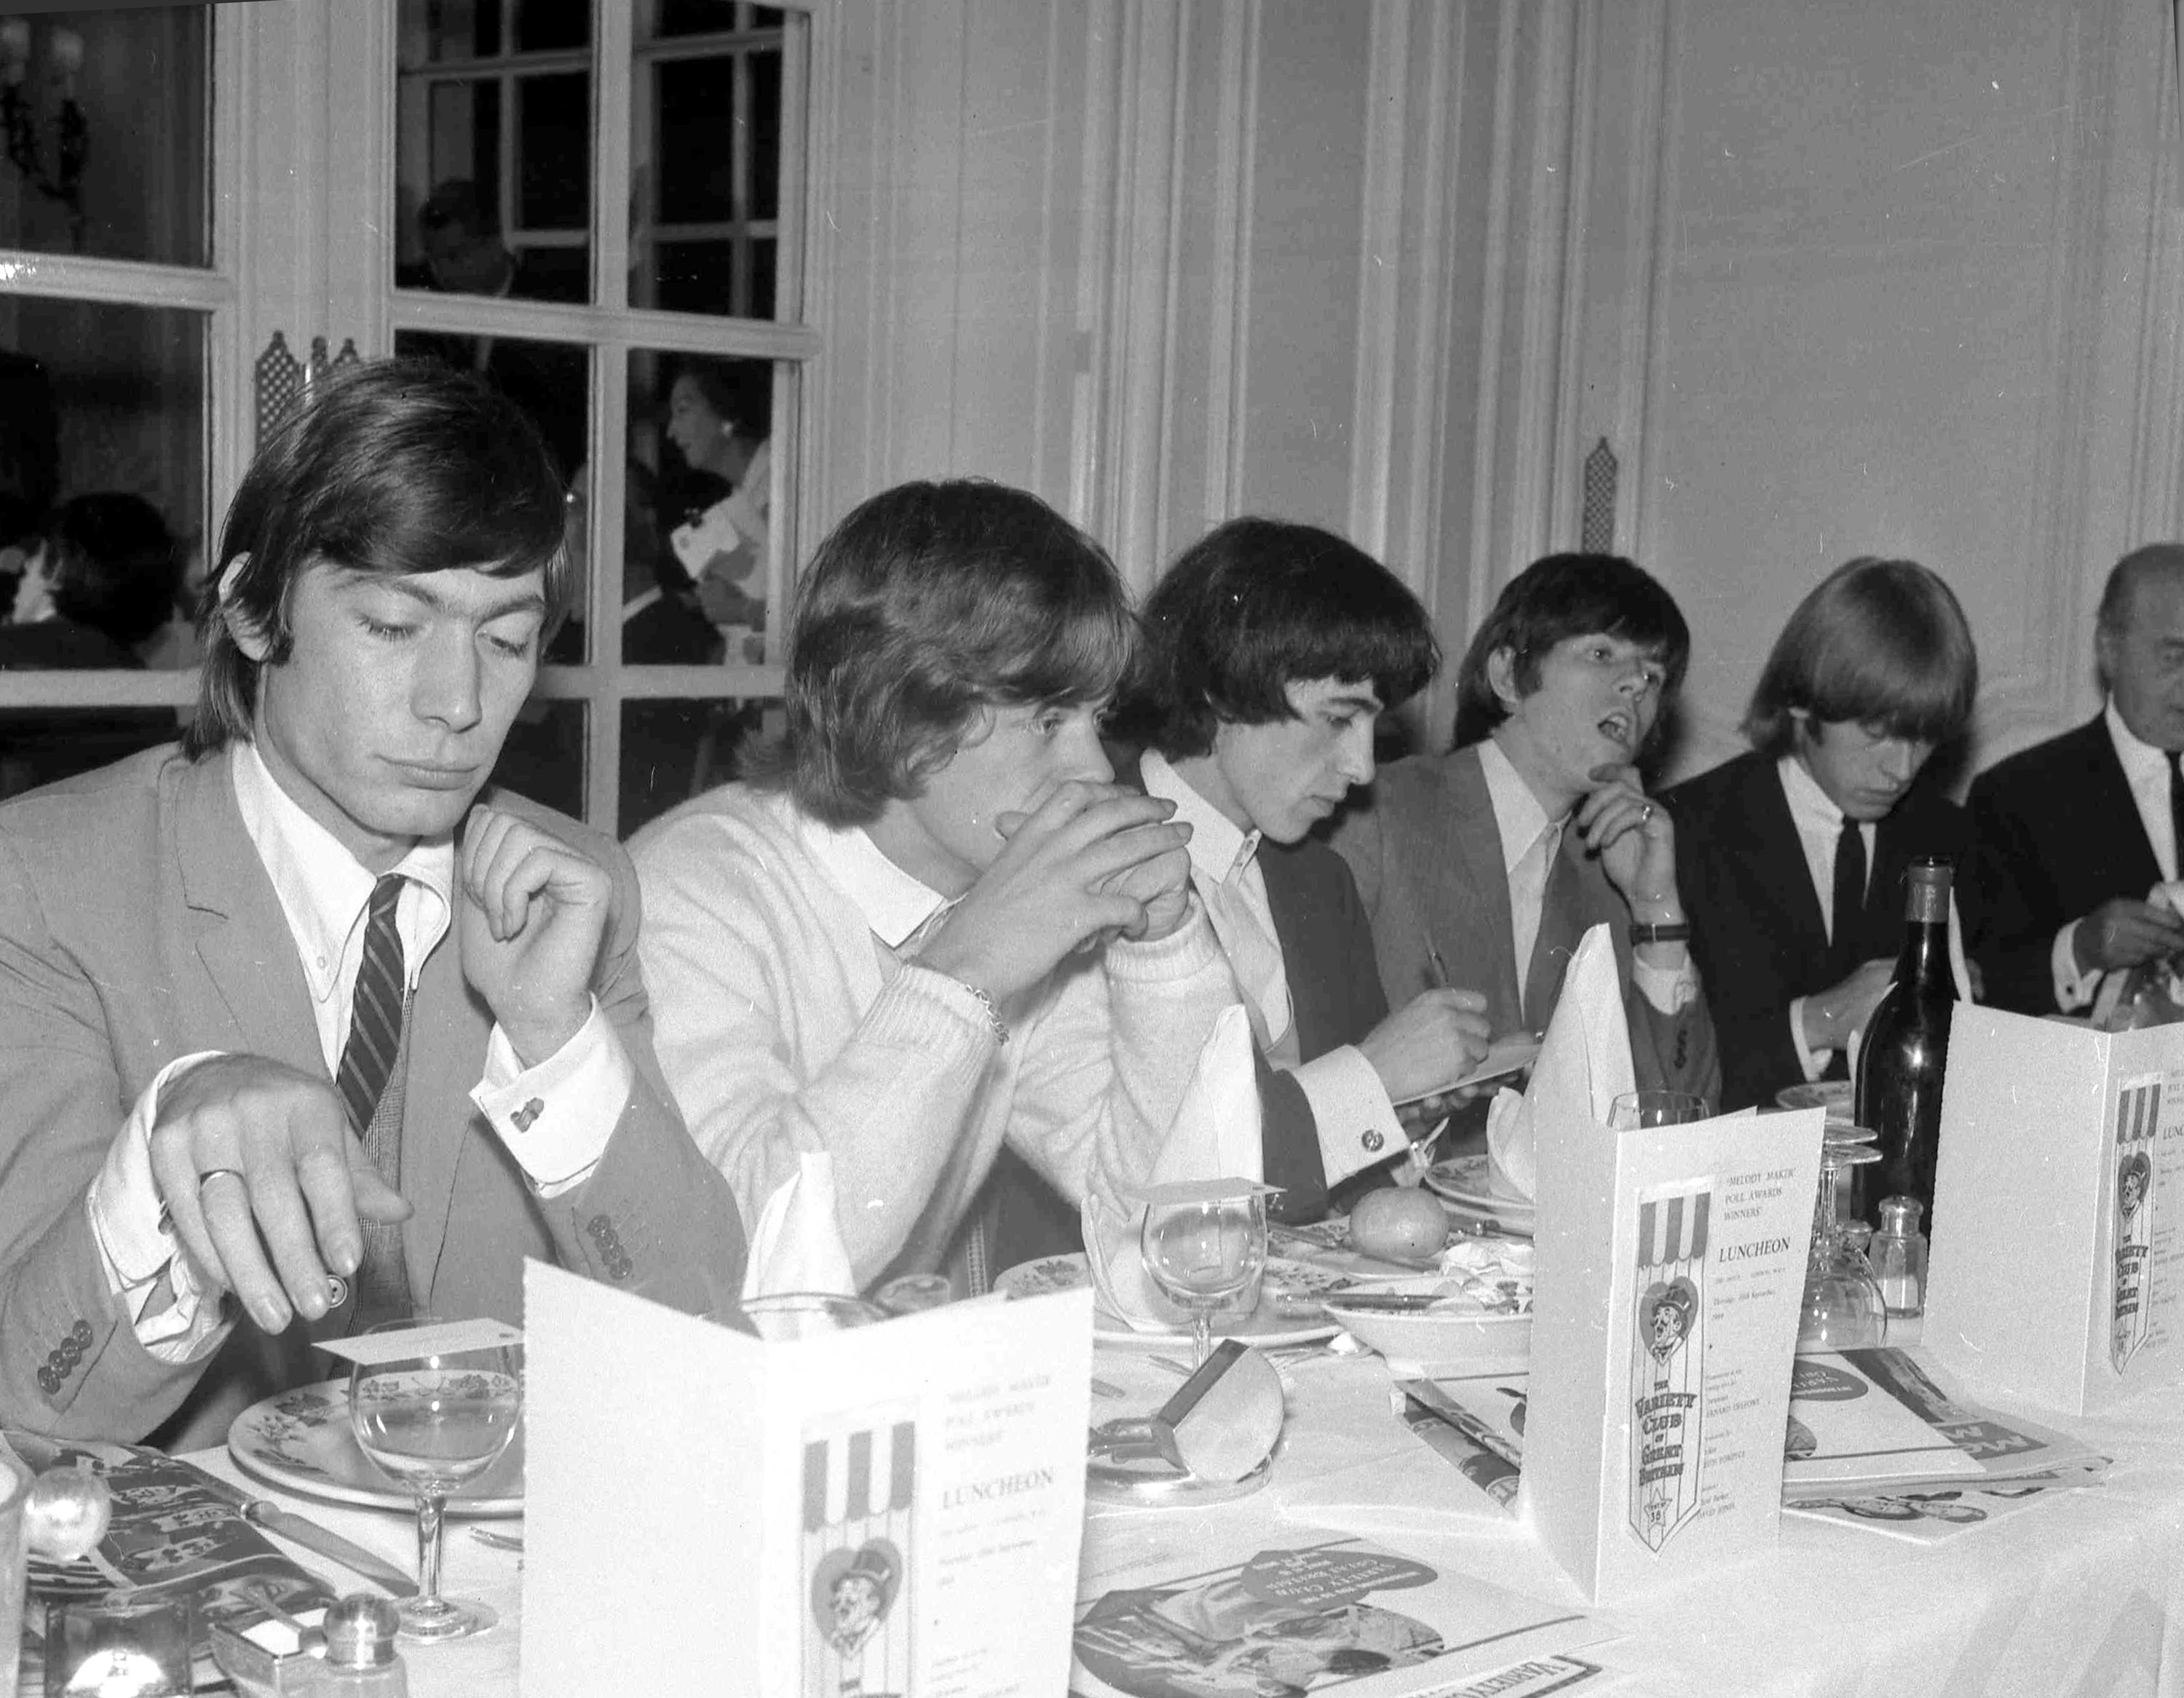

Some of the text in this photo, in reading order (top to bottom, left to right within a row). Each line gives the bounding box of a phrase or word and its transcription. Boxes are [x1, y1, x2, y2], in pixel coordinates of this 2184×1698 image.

[1719, 1236, 1790, 1263] LUNCHEON
[1634, 1392, 1698, 1419] VARIETY
[1642, 1413, 1682, 1435] CLUB
[1642, 1444, 1682, 1466] GREAT
[1639, 1463, 1685, 1487] BRITAIN
[941, 1466, 1056, 1510] LUNCHEON
